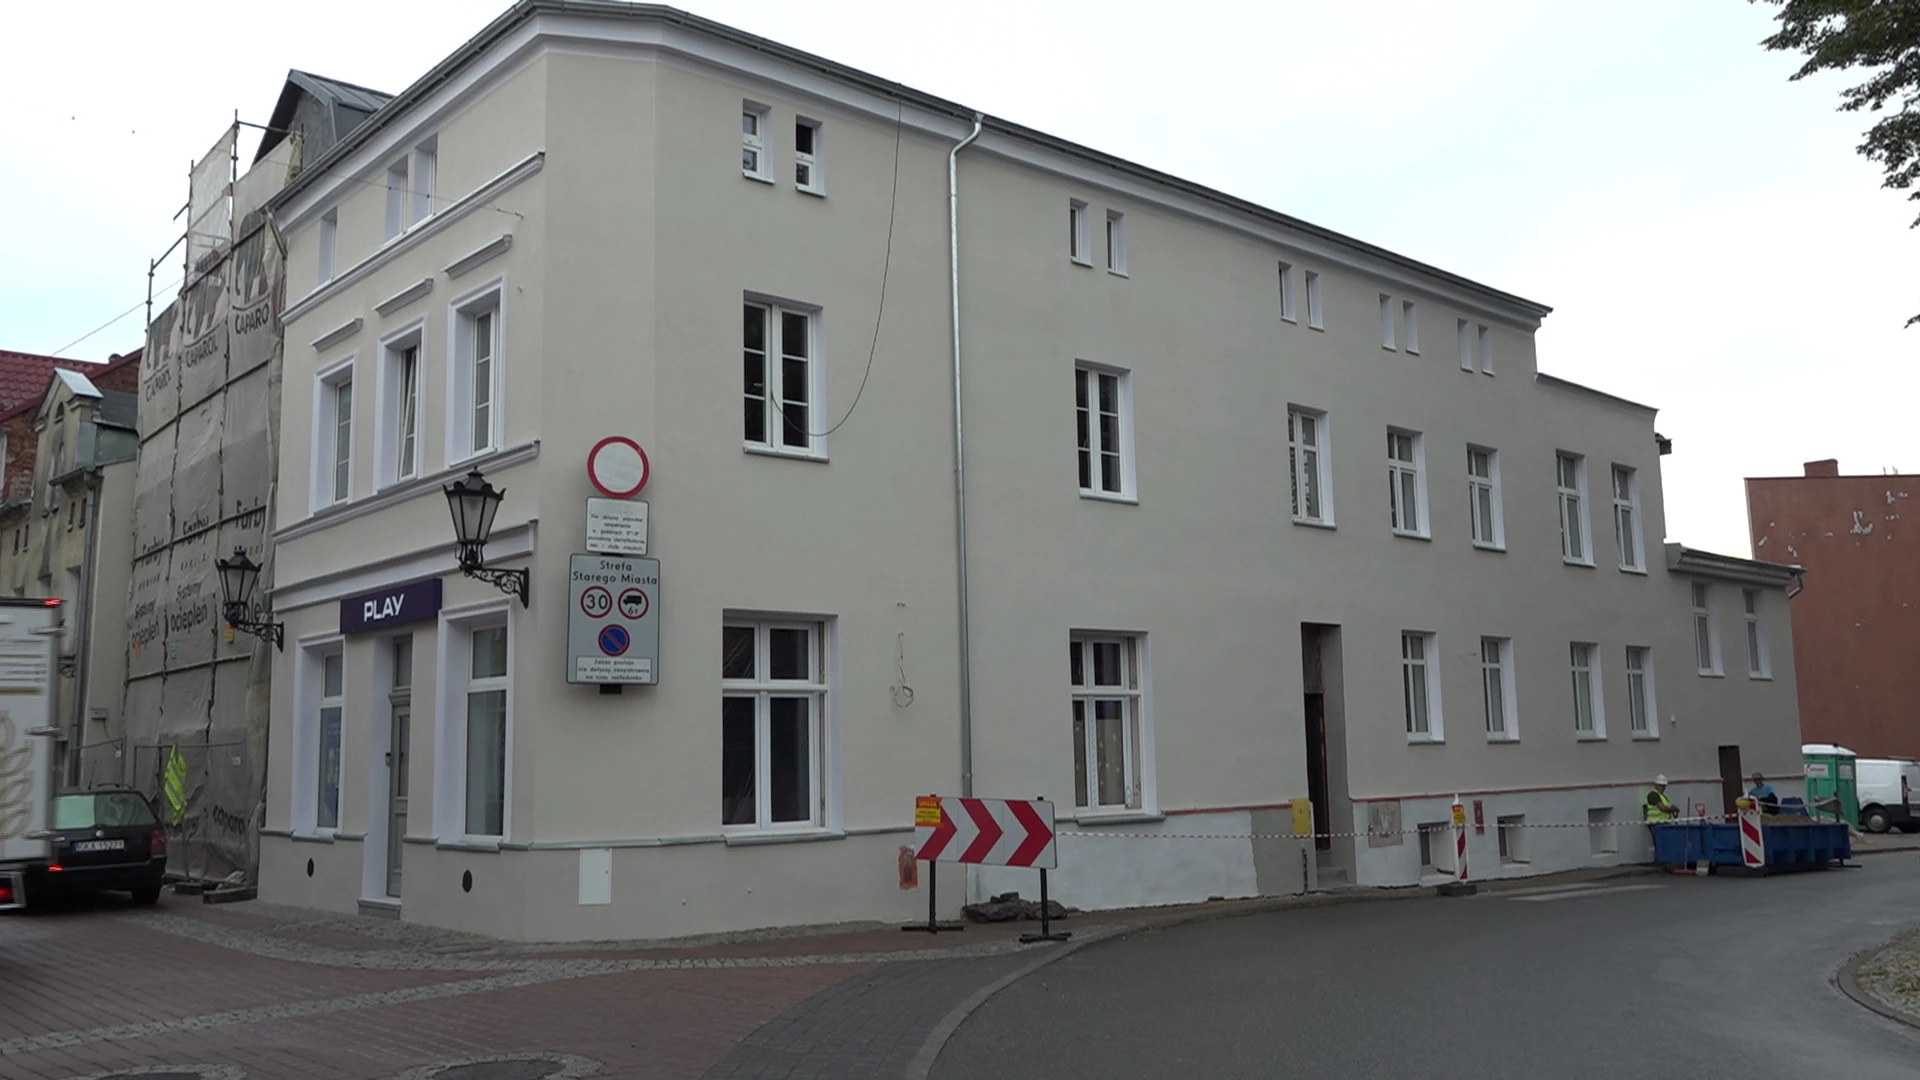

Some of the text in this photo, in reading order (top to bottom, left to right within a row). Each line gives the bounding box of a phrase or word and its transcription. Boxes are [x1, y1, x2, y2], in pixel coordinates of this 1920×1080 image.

[600, 560, 632, 571] Strefa
[573, 571, 657, 585] Starego Miasta
[363, 594, 404, 622] PLAY
[586, 594, 608, 610] 30
